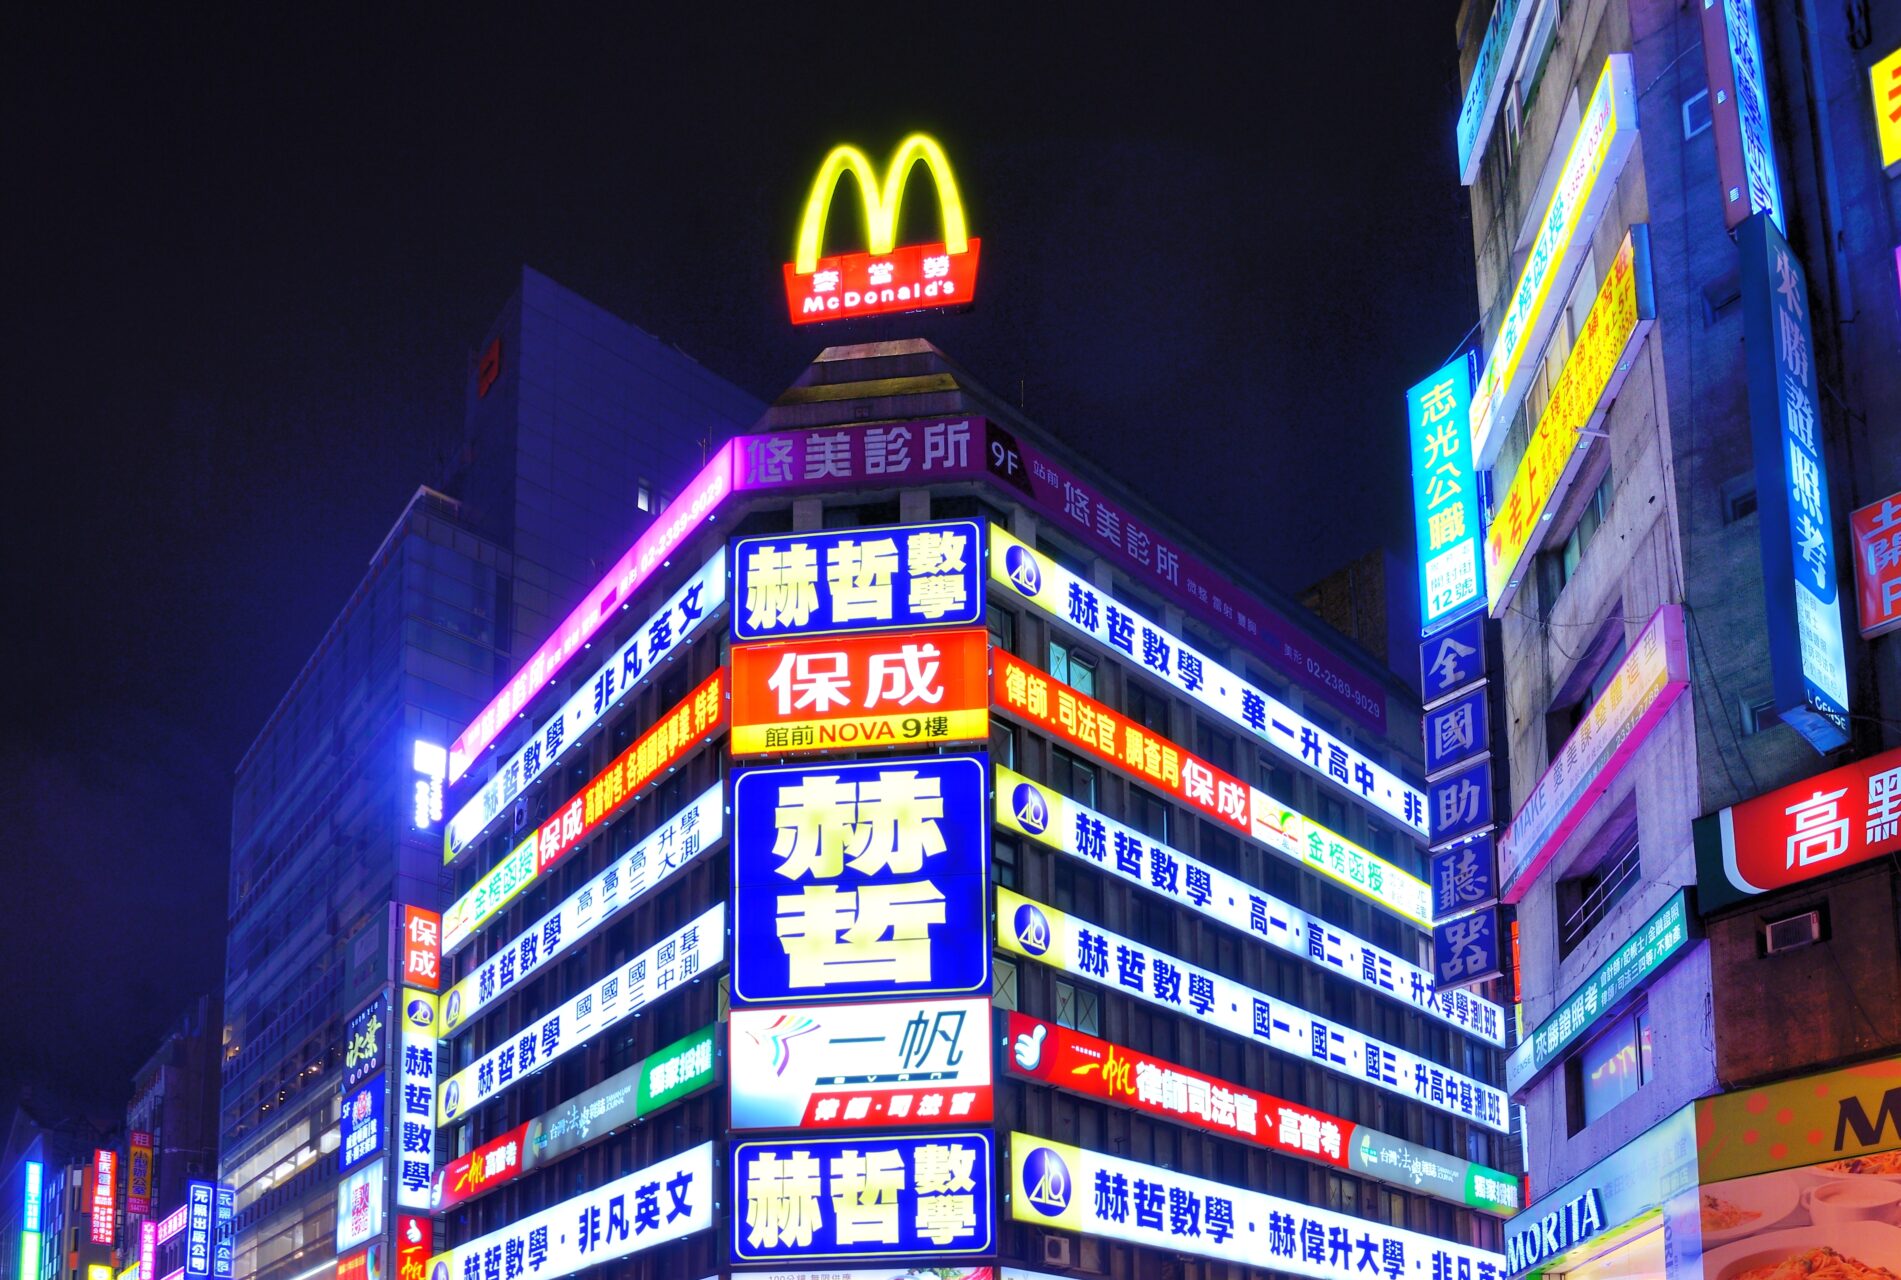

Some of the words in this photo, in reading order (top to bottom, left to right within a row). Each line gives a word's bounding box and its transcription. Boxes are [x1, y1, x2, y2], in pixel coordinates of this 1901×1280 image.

[802, 279, 955, 314] McDonald's
[812, 254, 950, 292] 麥當勞
[746, 421, 971, 484] 悠美診所
[991, 440, 1019, 476] 9F
[1420, 378, 1465, 551] 志光公職
[746, 531, 967, 630] 赫哲數學
[1033, 459, 1059, 489] 站前
[1063, 480, 1179, 587] 悠美診所
[1306, 656, 1381, 719] 02-2389-9029
[594, 580, 704, 715] 非凡英文
[768, 643, 944, 715] 保成
[1068, 581, 1204, 693] 赫哲數學
[1242, 688, 1374, 797] 華一升高中
[819, 721, 895, 744] NOVA
[539, 799, 583, 866] 保成
[1182, 758, 1248, 826] 保成
[1428, 637, 1490, 982] 全國助聽器
[1514, 782, 1547, 847] MAKE
[1076, 812, 1212, 907] 赫哲數學
[1307, 831, 1384, 895] 金榜函授
[409, 916, 437, 979] 保成
[478, 913, 562, 1004] 赫哲數學
[478, 1015, 560, 1098] 赫哲數學
[829, 1010, 967, 1069] 一帆
[1078, 928, 1215, 1015] 赫哲數學
[1415, 1063, 1501, 1126] 升高中基測班
[134, 1134, 149, 1146] 租
[402, 1045, 433, 1192] 赫哲數學
[191, 1189, 208, 1271] 元照出版公司
[578, 1170, 693, 1255] 非凡英文
[746, 1143, 977, 1249] 赫哲數學
[1094, 1168, 1234, 1244] 赫哲數學
[1269, 1211, 1405, 1280] 赫偉升大學
[1506, 1188, 1601, 1277] MORITA
